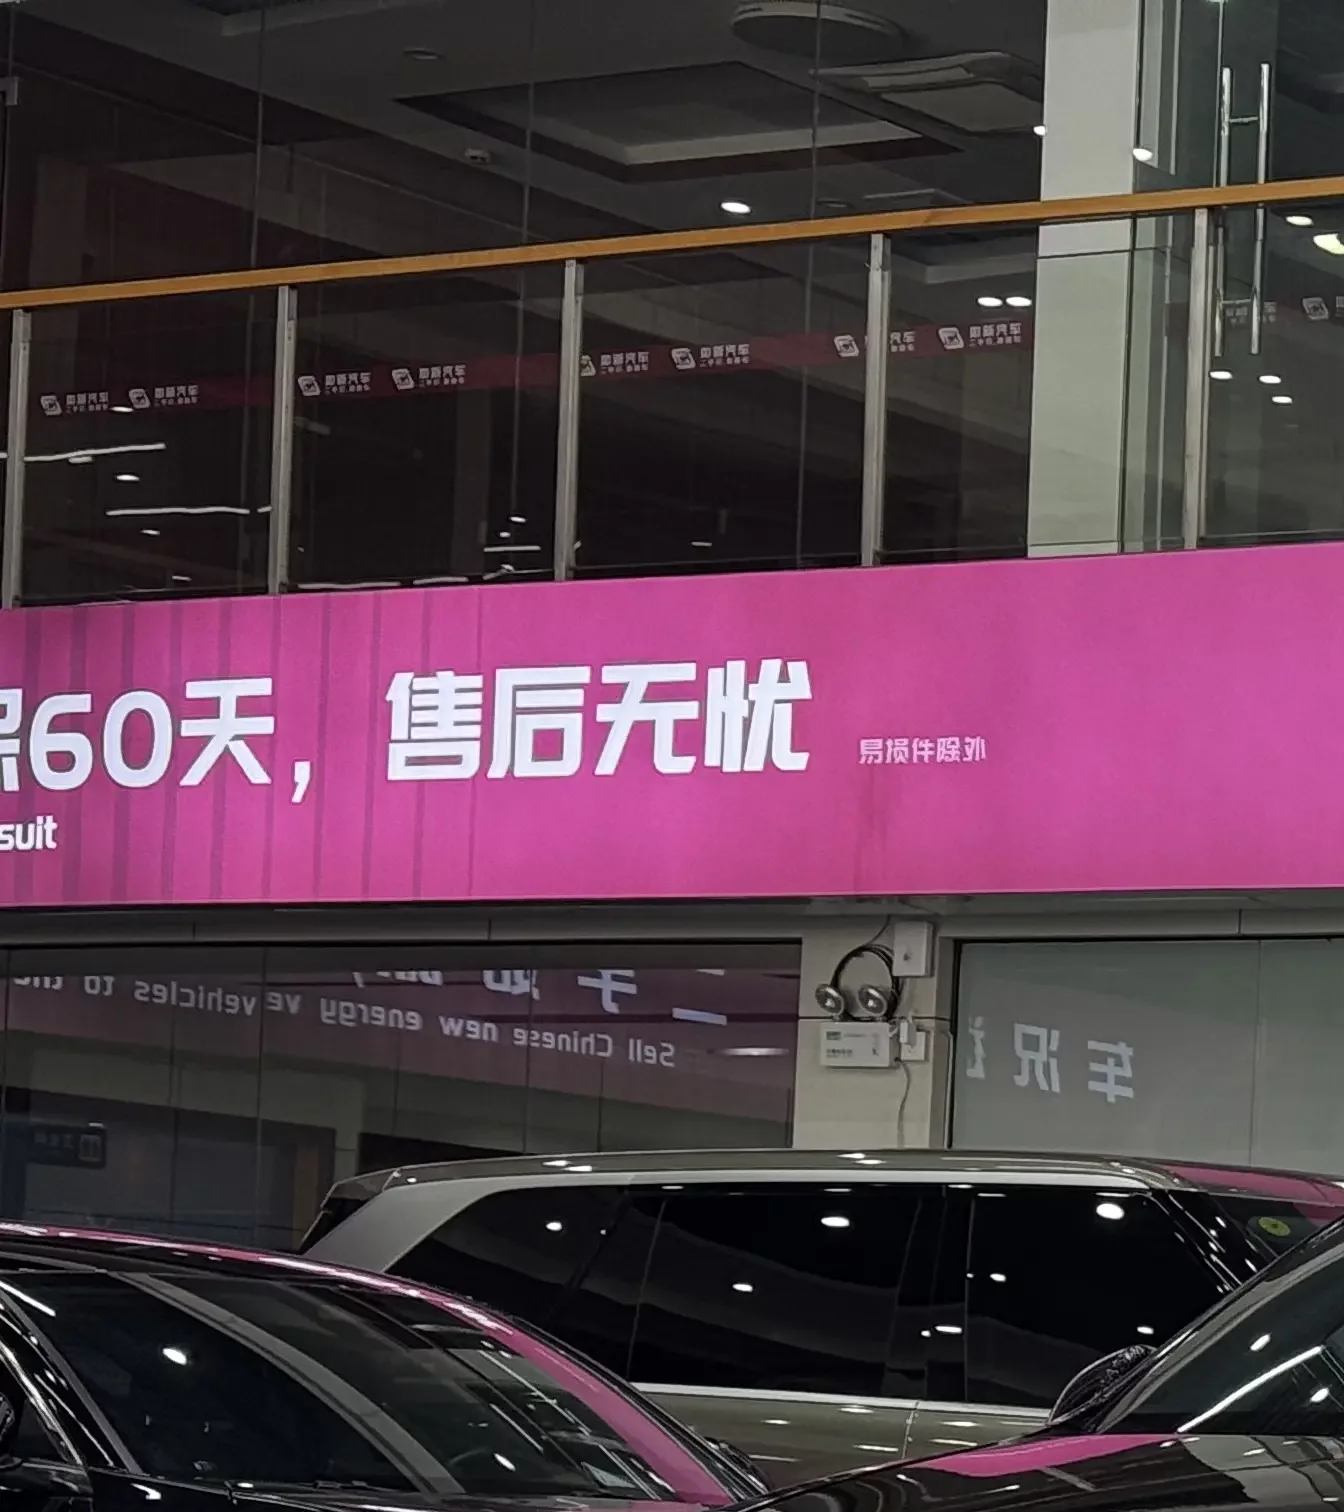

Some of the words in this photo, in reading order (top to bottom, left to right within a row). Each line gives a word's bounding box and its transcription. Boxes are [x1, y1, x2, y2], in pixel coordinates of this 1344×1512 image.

[0, 658, 812, 803] 60天，售后无忧
[858, 735, 987, 765] 易损件除外
